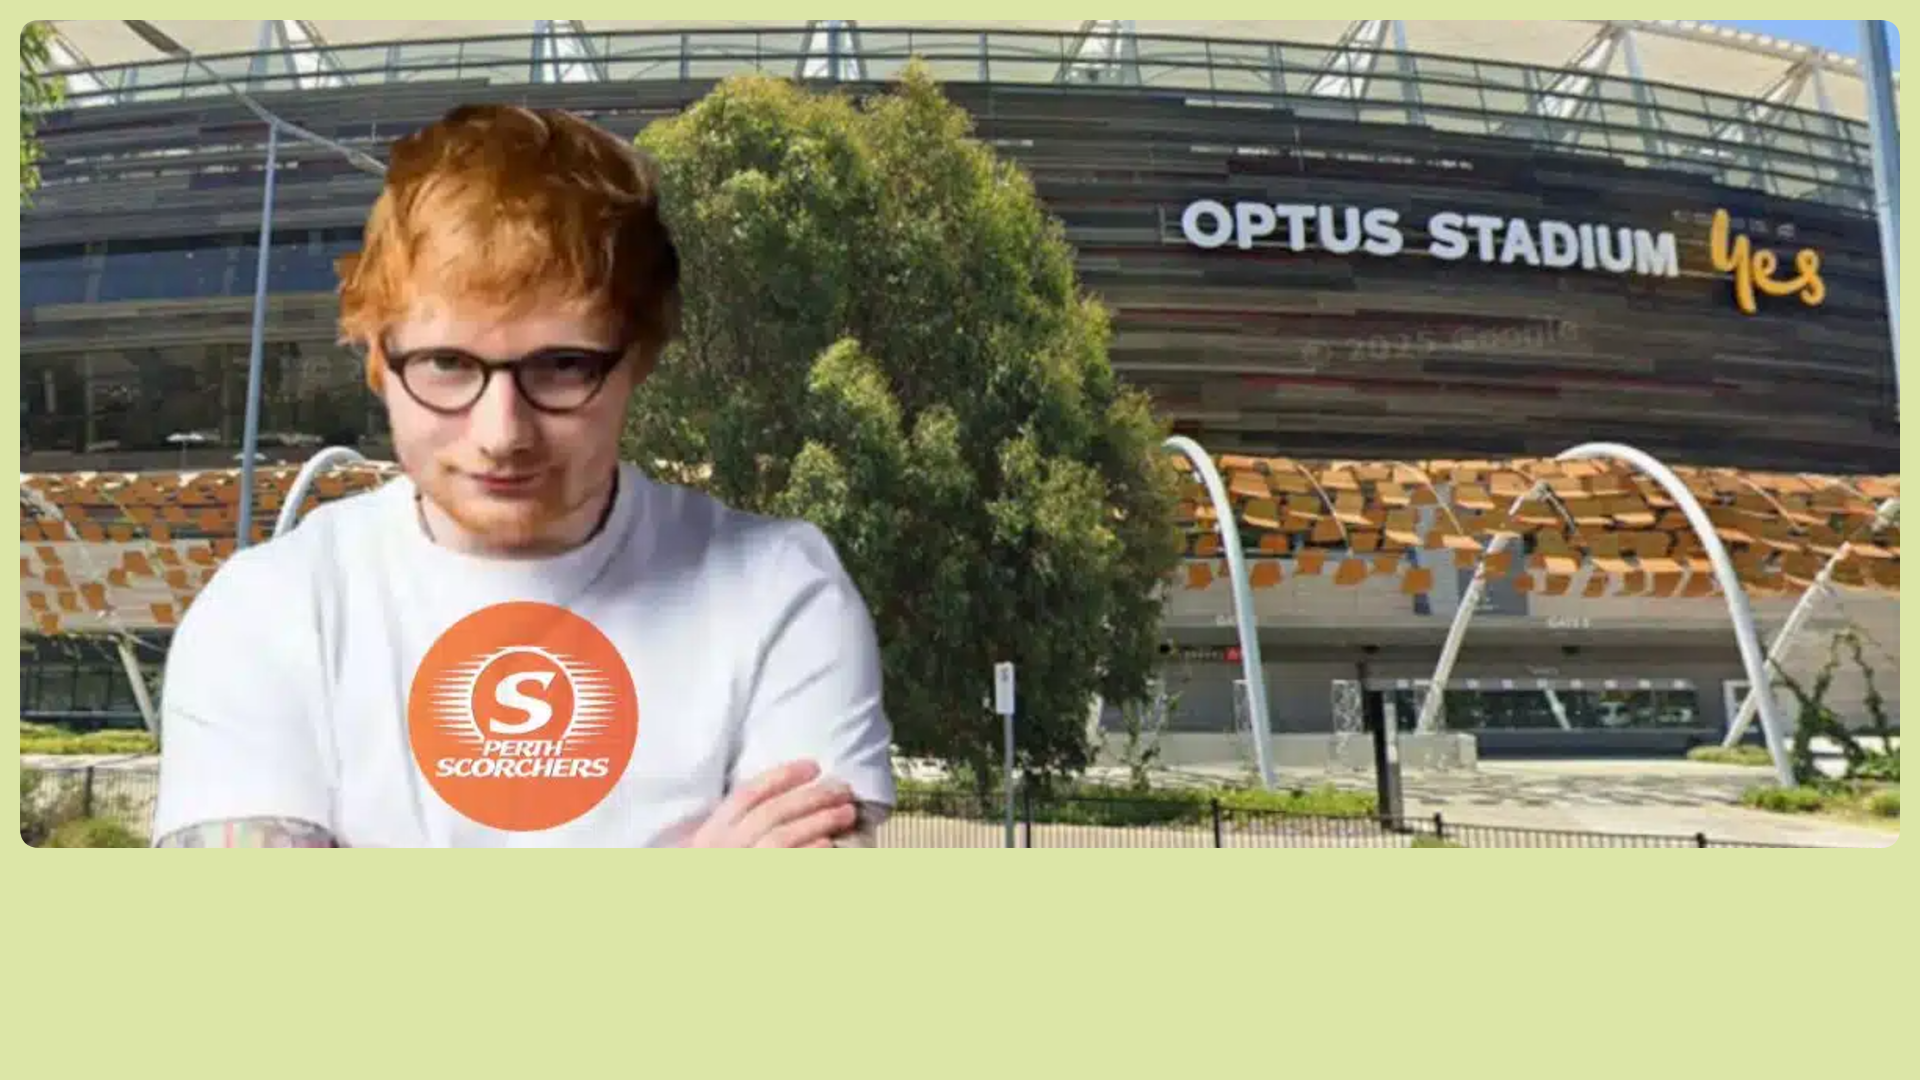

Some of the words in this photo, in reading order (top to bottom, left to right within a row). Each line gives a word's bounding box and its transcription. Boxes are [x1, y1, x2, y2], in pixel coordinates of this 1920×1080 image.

[1181, 199, 1404, 256] OPTUS
[1428, 212, 1679, 278] STADIUM
[489, 671, 556, 734] S
[436, 758, 610, 778] SCORCHERS
[482, 740, 564, 757] PERTH
